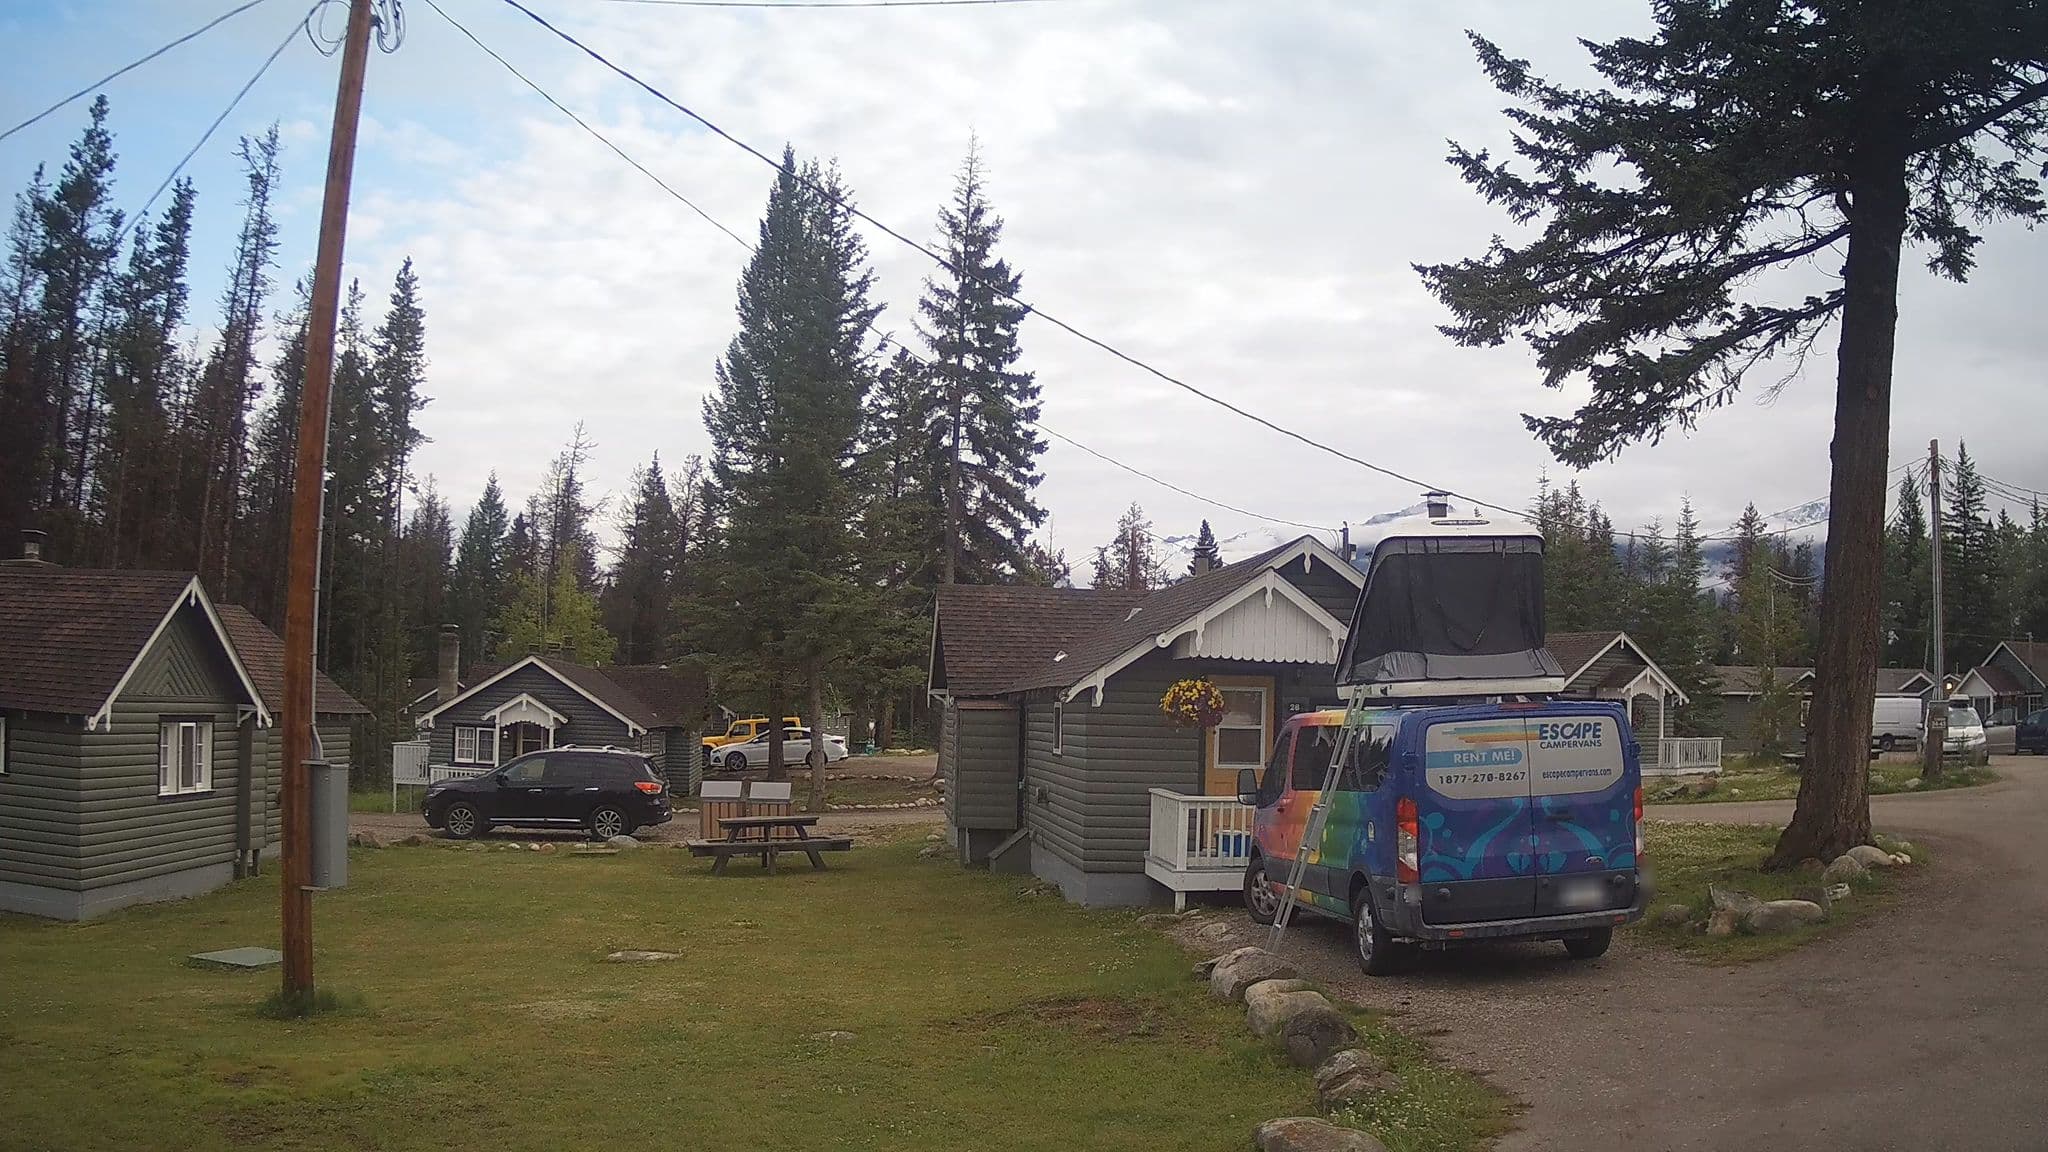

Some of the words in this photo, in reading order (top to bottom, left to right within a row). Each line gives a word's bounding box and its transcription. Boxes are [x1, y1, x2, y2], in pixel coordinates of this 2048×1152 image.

[1538, 722, 1602, 741] ESCAPE
[1540, 739, 1602, 750] CAMPERVANS
[1454, 752, 1486, 764] RENT
[1492, 750, 1515, 761] ME!
[1439, 771, 1526, 785] 1877-270-8267
[1542, 768, 1612, 779] escapecampervans.com
